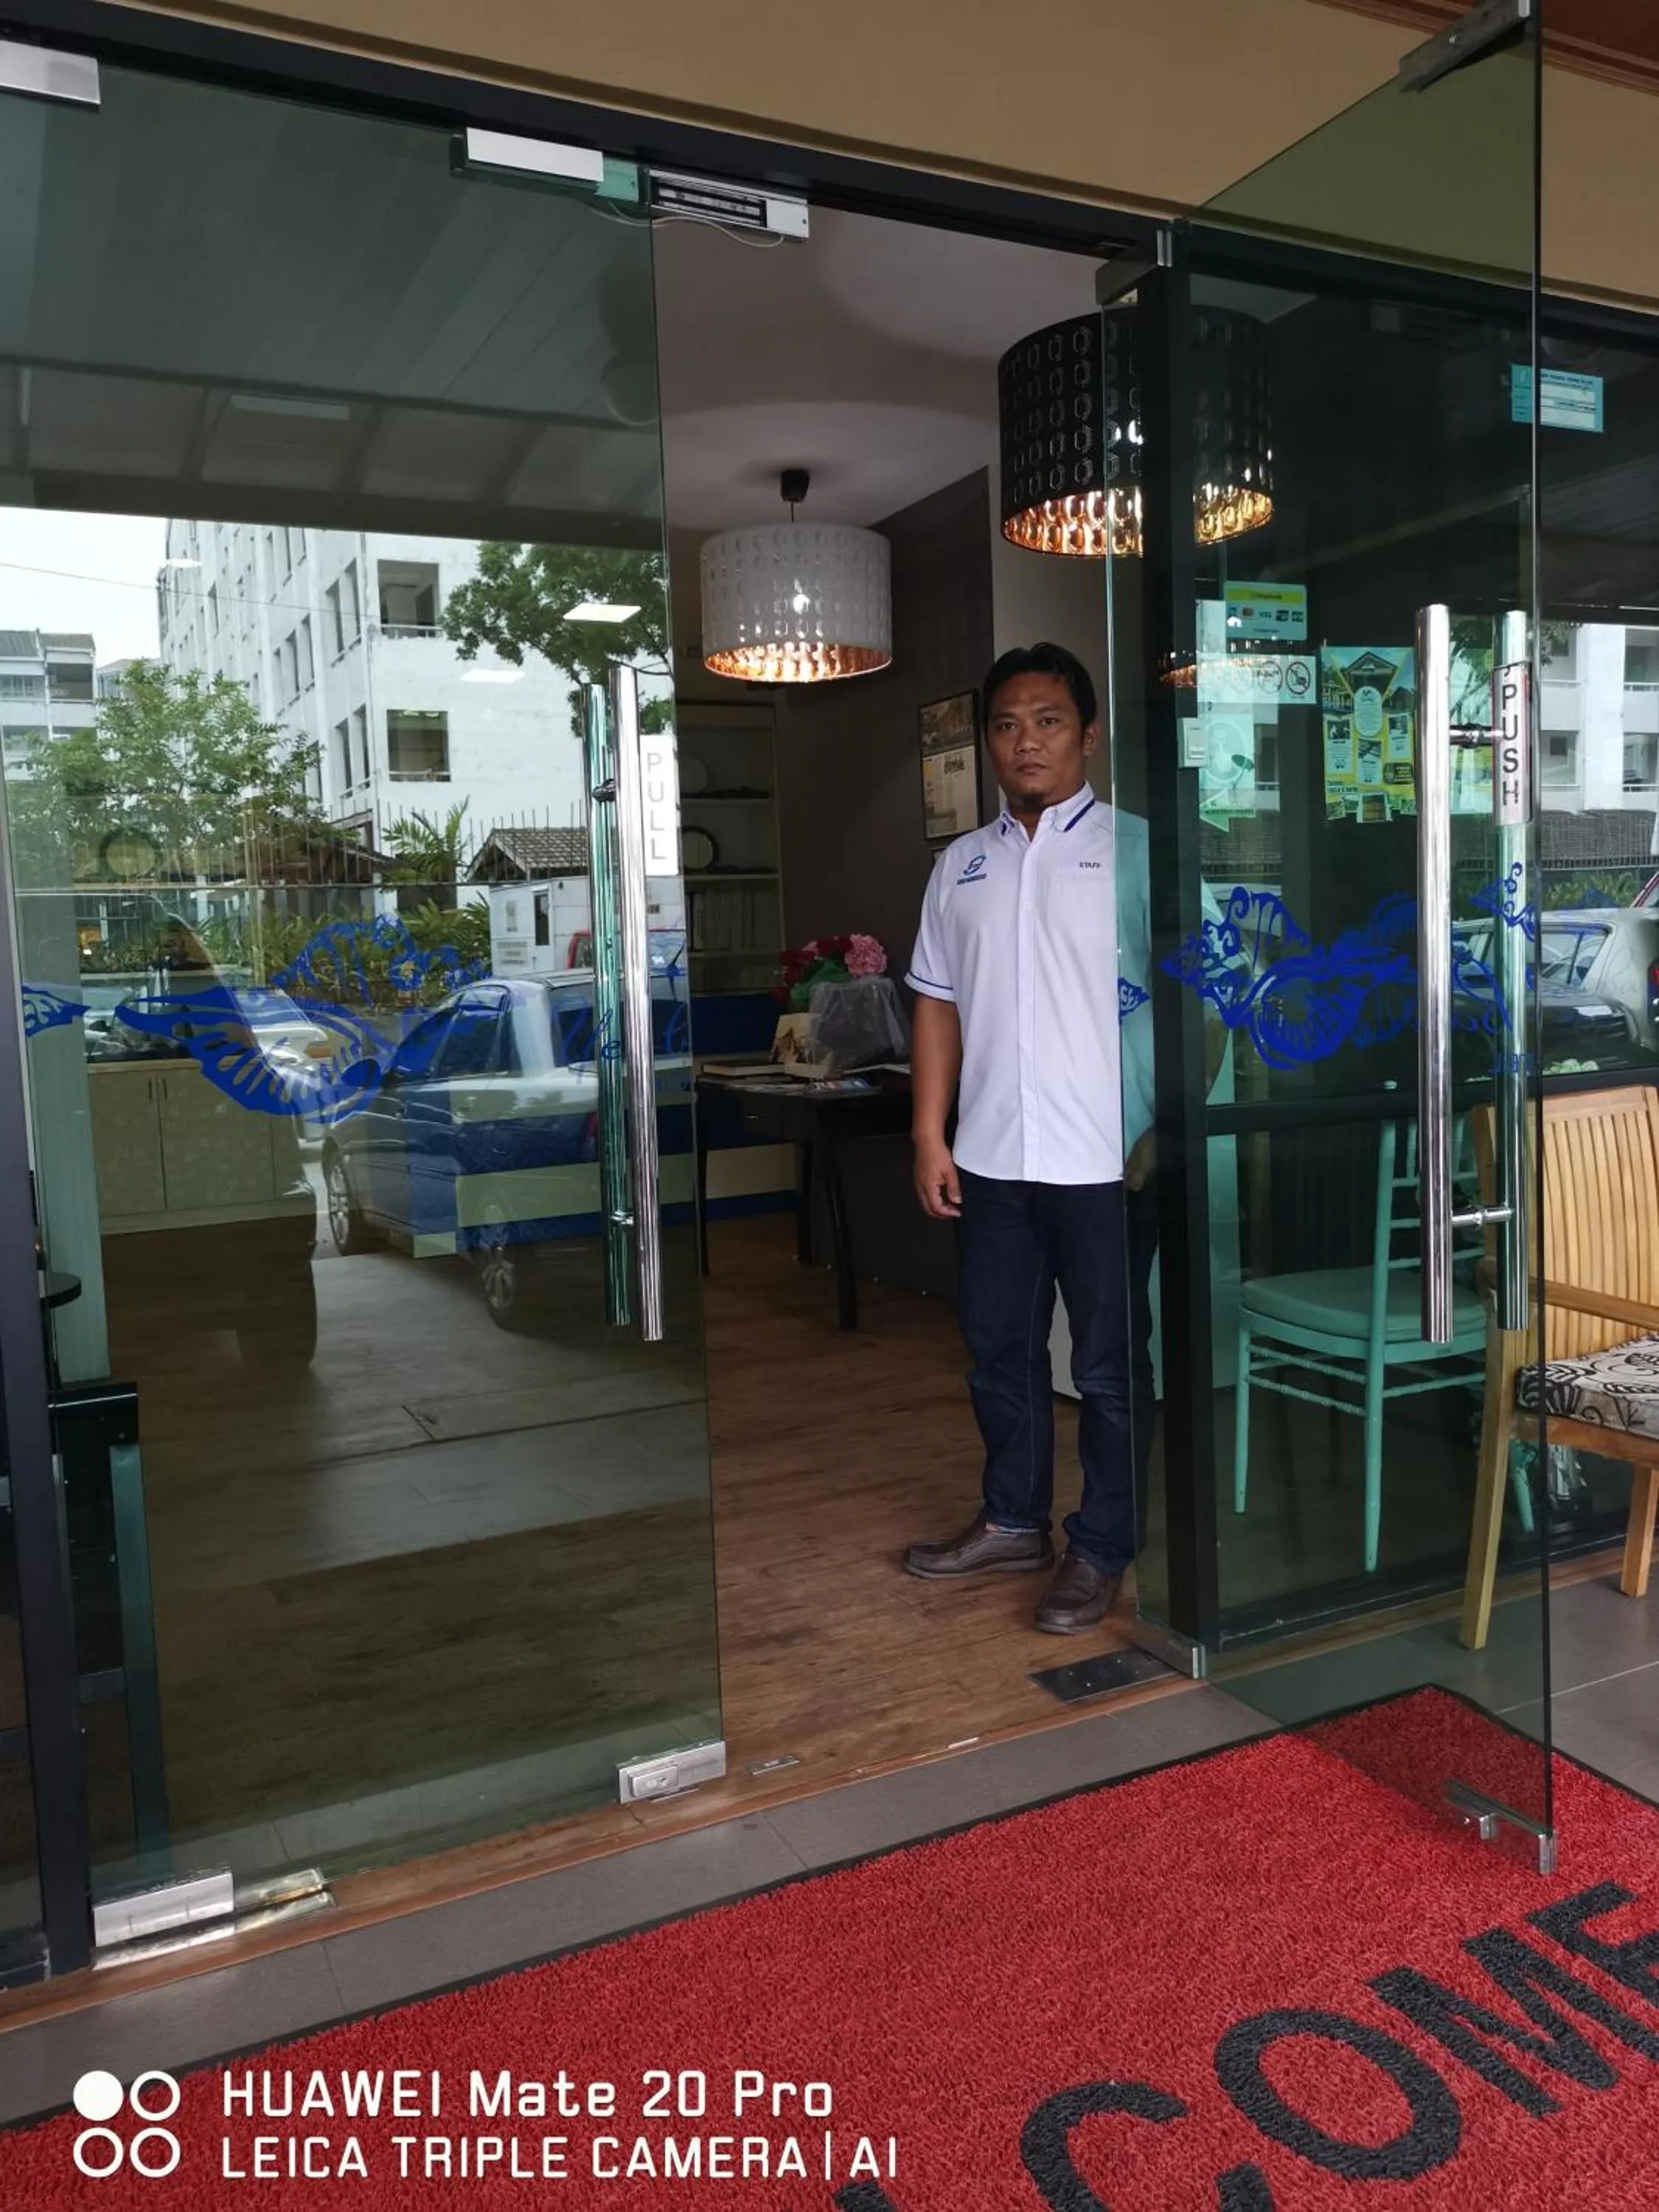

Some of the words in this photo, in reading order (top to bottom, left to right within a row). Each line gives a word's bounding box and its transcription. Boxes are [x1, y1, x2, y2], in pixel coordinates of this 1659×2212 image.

[647, 752, 667, 860] PULL
[1502, 683, 1519, 806] PUSH
[835, 1879, 1659, 2212] COME
